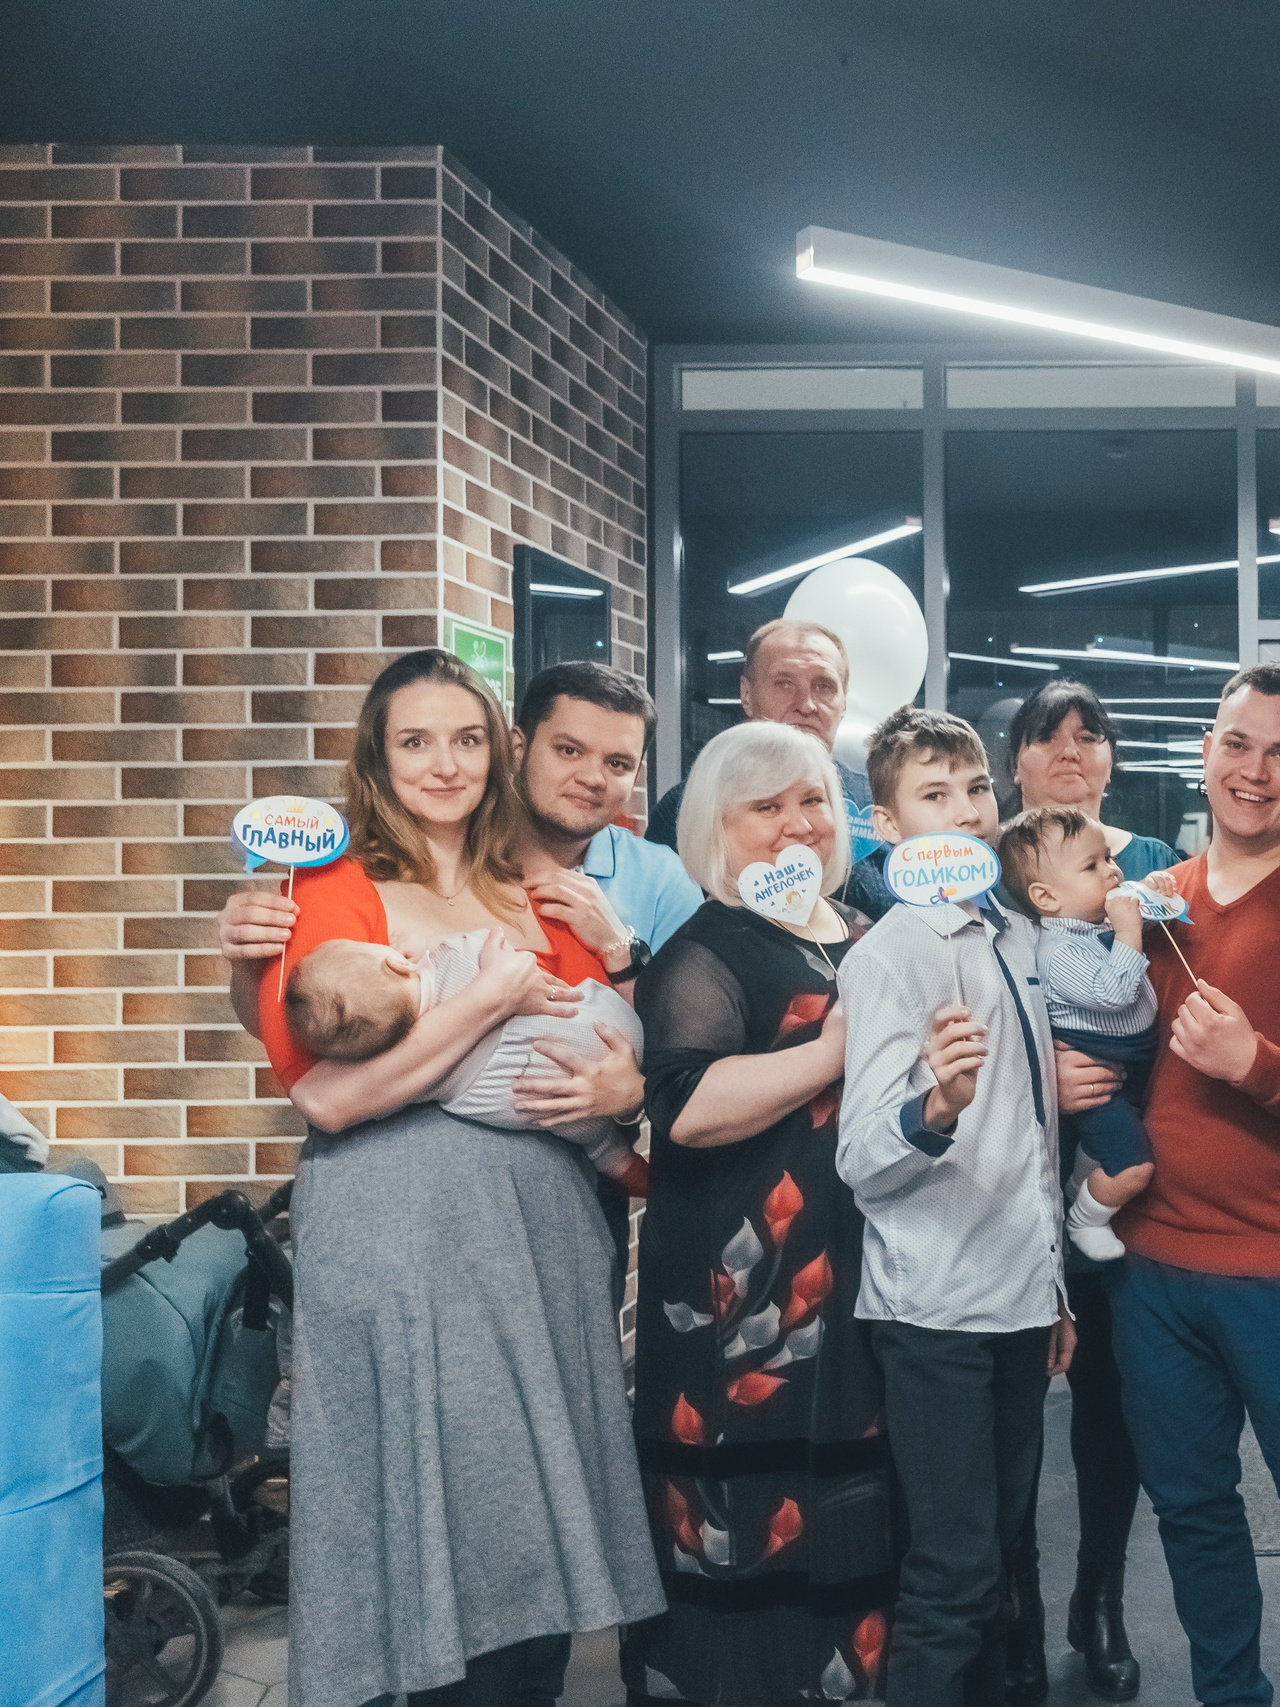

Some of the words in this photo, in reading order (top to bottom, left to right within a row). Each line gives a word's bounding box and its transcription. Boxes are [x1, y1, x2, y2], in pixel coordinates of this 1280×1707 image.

[902, 847, 913, 862] С
[917, 844, 973, 867] первым
[755, 867, 814, 903] АНГЕЛОЧЕК
[763, 864, 795, 884] Наш
[893, 861, 994, 888] ГОДИКОМ!
[1138, 902, 1180, 919] ОДИК
